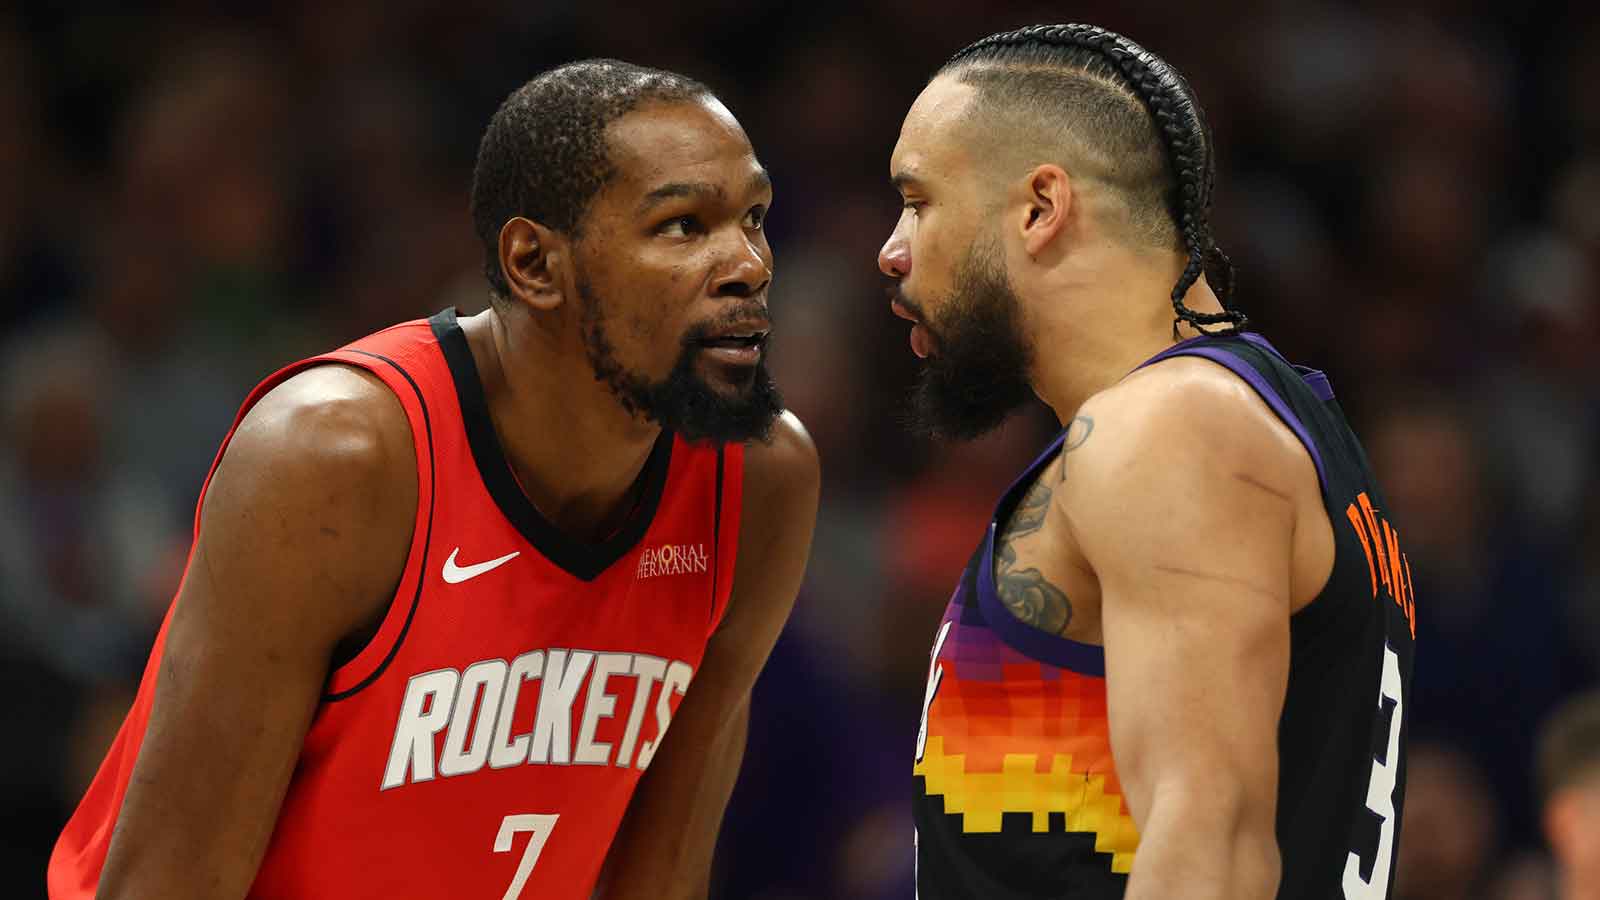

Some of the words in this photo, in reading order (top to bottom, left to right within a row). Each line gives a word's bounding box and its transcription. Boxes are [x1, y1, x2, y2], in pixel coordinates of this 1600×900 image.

[380, 648, 693, 791] ROCKETS
[1342, 643, 1403, 900] 3
[493, 813, 560, 900] 7
